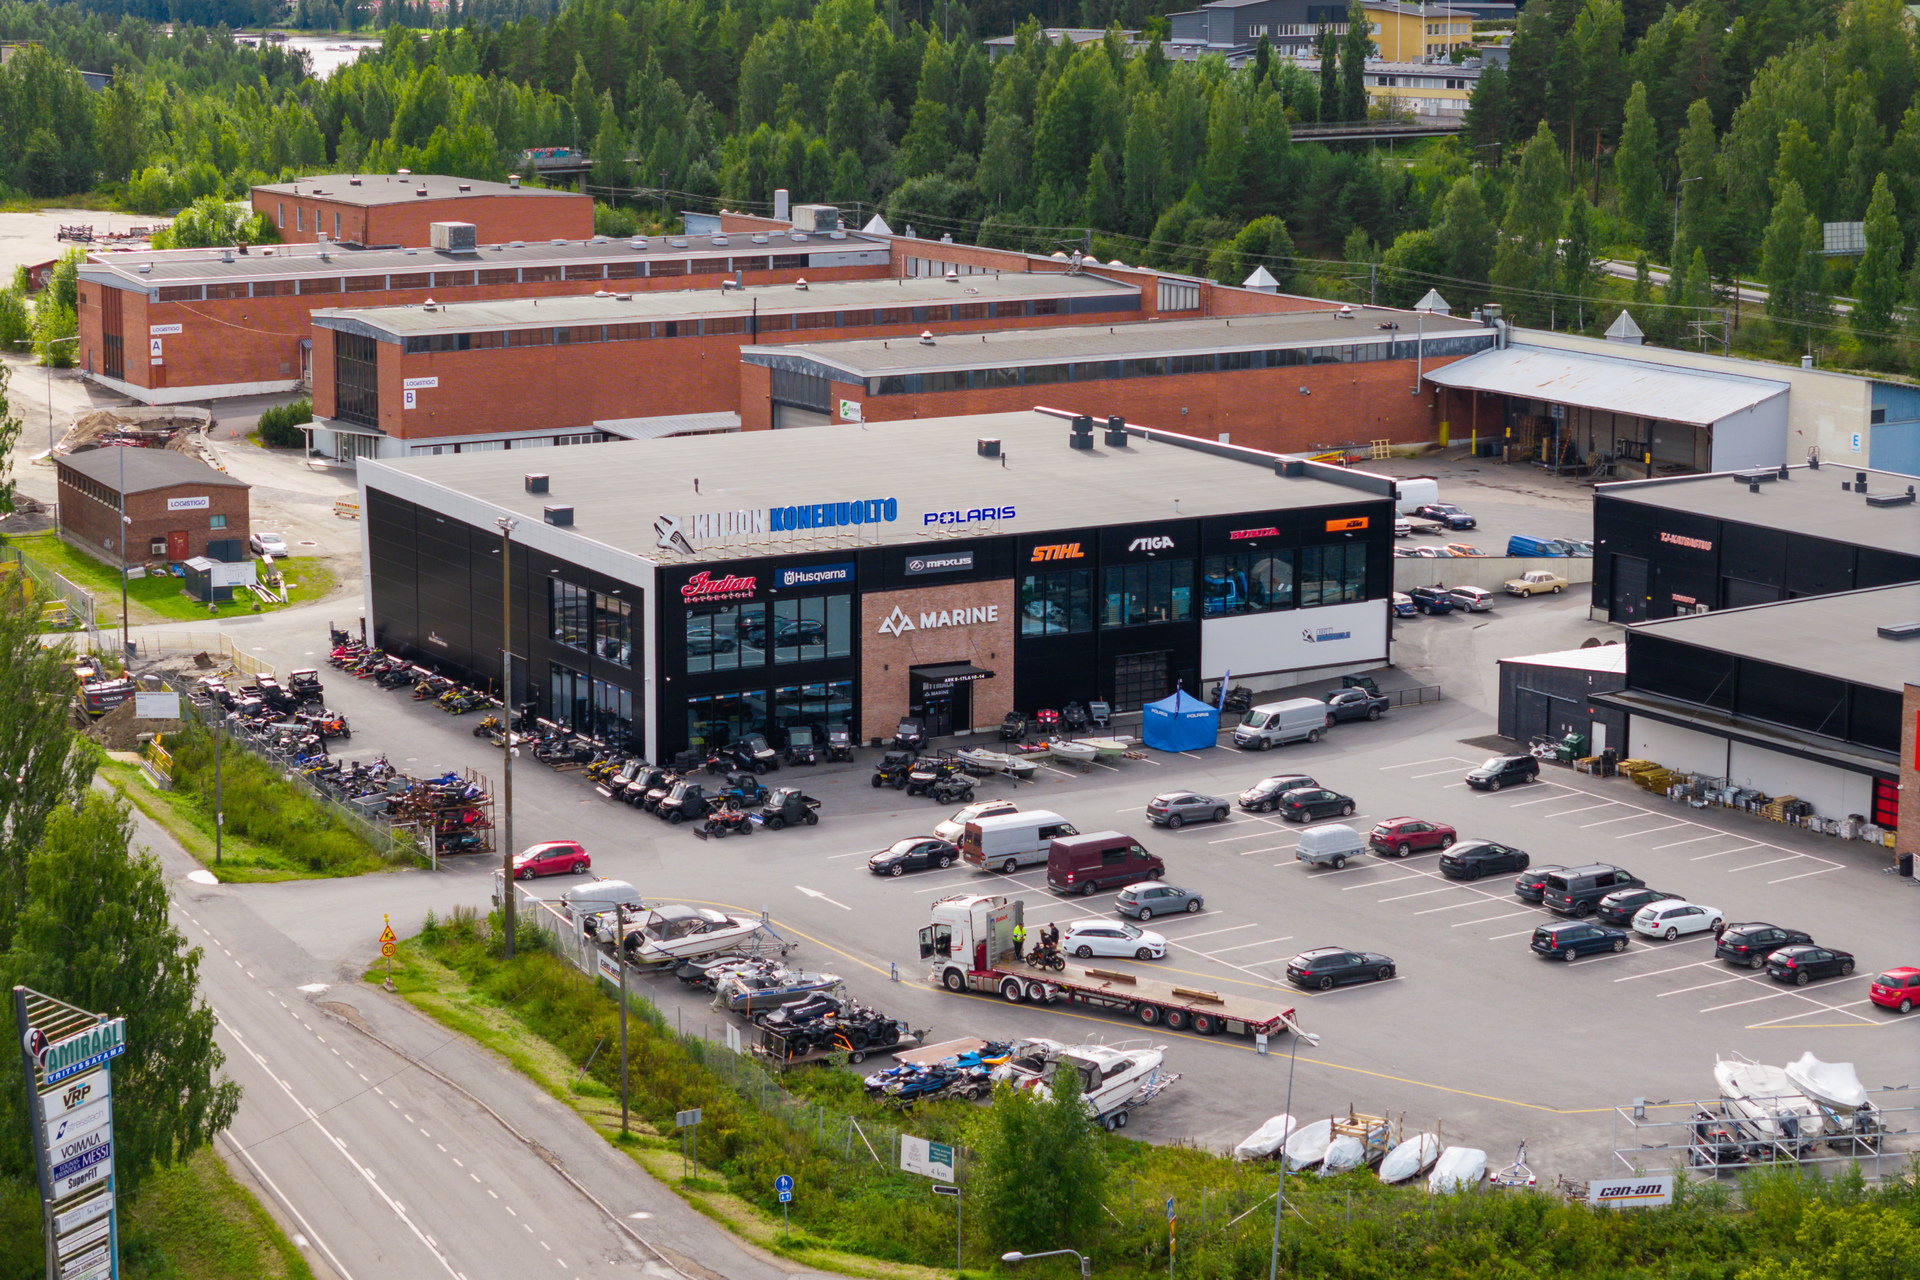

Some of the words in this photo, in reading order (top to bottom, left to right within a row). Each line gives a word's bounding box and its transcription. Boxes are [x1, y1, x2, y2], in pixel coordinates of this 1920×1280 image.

[152, 340, 161, 351] A
[406, 379, 436, 387] LOGISTIGO
[406, 392, 414, 403] B
[1853, 434, 1859, 446] E
[170, 499, 206, 508] LOGISTIGO
[693, 508, 766, 540] KELJON
[769, 497, 898, 532] KONEHUOLTO
[923, 506, 1017, 527] POLARIS
[1345, 520, 1363, 529] KTM
[1229, 527, 1280, 540] HONDA
[1128, 536, 1175, 552] STIGA
[1030, 543, 1084, 562] STIHL
[926, 557, 972, 569] MAXUS
[680, 570, 757, 597] Indian
[795, 569, 847, 583] Husqvarna
[684, 591, 754, 604] MOTORCYCLE
[919, 605, 999, 630] MARINE
[384, 946, 394, 954] 30
[48, 1019, 126, 1073] AMIRAALI
[48, 1045, 125, 1082] YRITYSSATAMA
[63, 1085, 91, 1107] VRP
[67, 1109, 104, 1132] stresstech
[61, 1132, 101, 1159] VOIMALA
[82, 1144, 109, 1168] MESSI
[68, 1166, 98, 1190] SuperFIT
[1599, 1184, 1662, 1197] can-am
